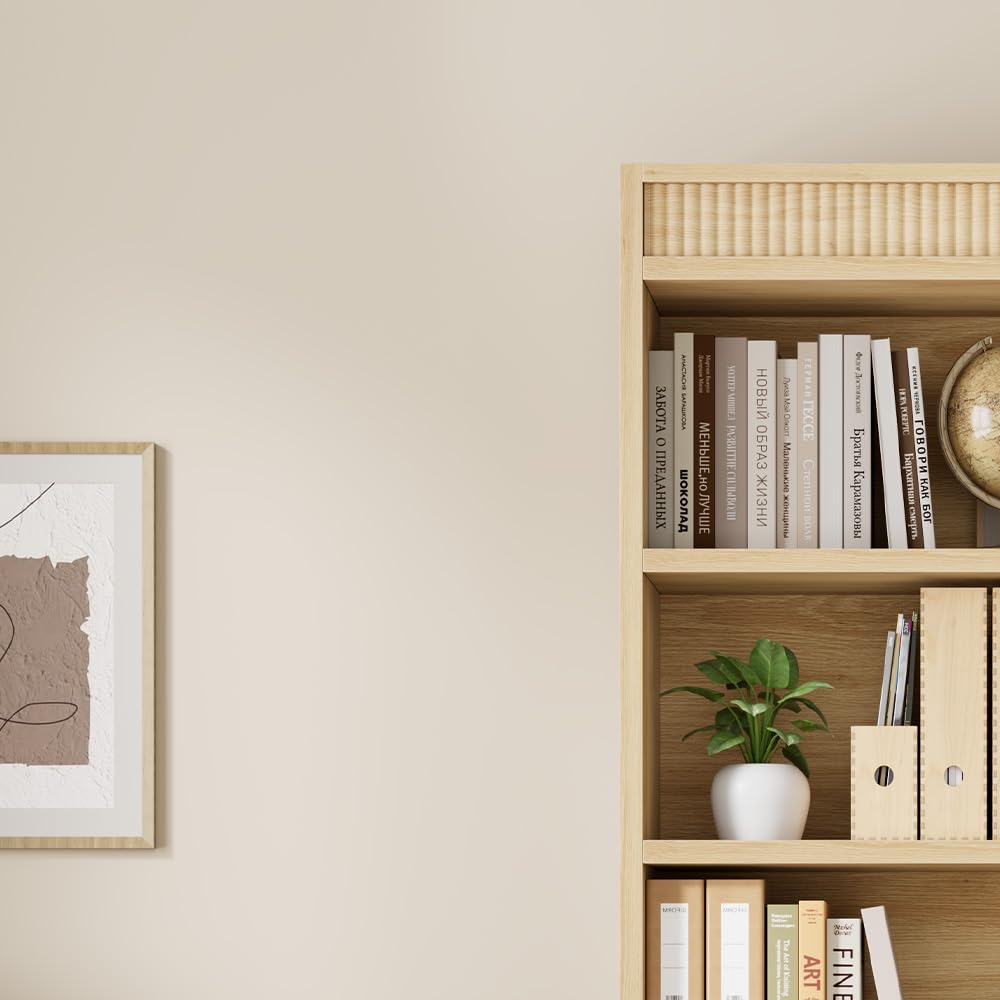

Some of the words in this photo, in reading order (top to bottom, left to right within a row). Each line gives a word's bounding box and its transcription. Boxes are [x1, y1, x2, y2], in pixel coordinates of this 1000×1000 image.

[656, 386, 666, 433] ЗАБОТА
[757, 368, 769, 420] НОВЫЙ
[656, 438, 666, 446] О
[803, 400, 814, 440] ГЕССЕ
[757, 425, 767, 470] ОБРАЗ
[783, 442, 791, 492] Маленькие
[850, 428, 864, 467] Братья
[915, 420, 927, 473] ГОВОРИ
[655, 451, 666, 529] ПРЕДАННЫХ
[678, 469, 688, 532] ШОКОЛАД
[757, 475, 767, 527] ЖИЗНИ
[902, 453, 916, 504] Бархатная
[920, 478, 930, 499] КАК
[699, 493, 710, 534] ЛУЧШЕ
[850, 471, 864, 539] Карамазовы
[908, 506, 919, 540] смерть
[923, 504, 931, 524] БОГ
[803, 955, 821, 990] ART
